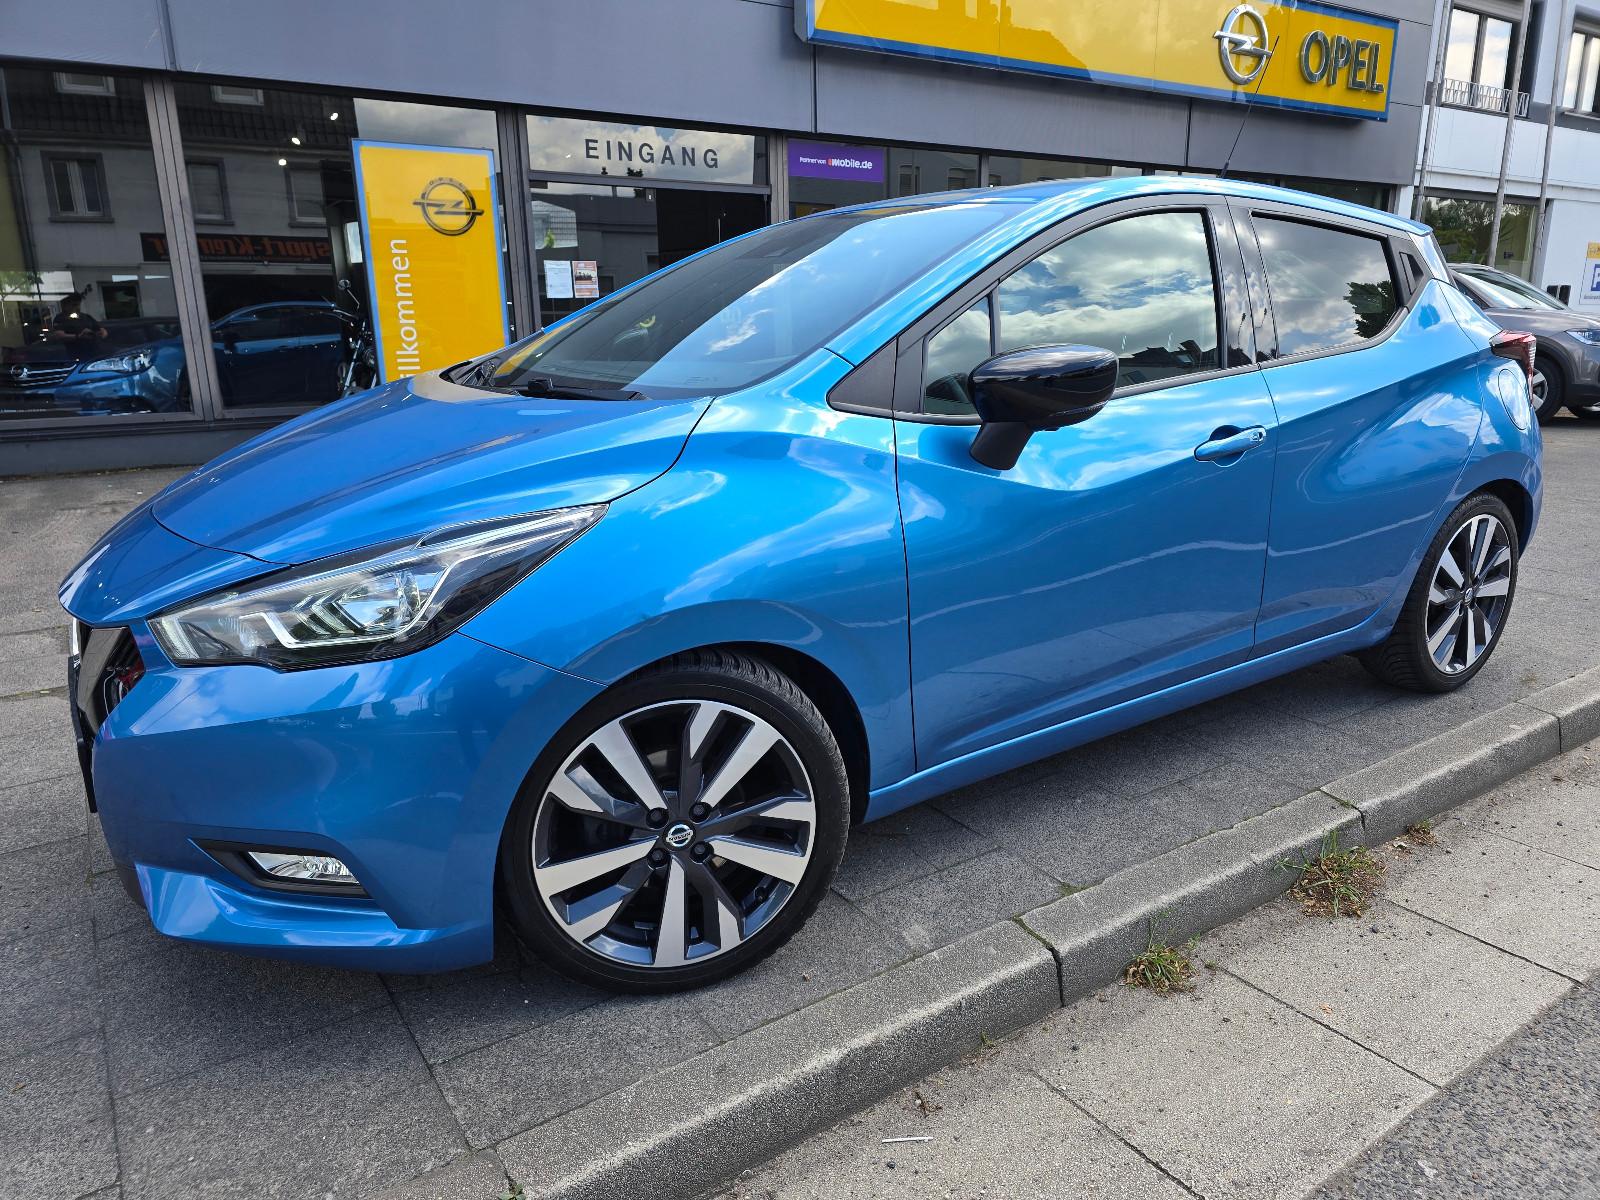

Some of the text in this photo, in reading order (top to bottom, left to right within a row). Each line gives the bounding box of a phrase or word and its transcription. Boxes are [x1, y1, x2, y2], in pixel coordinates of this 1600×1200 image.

[1301, 30, 1384, 93] OPEL
[585, 139, 718, 168] EINGANG
[390, 239, 421, 379] illkommen
